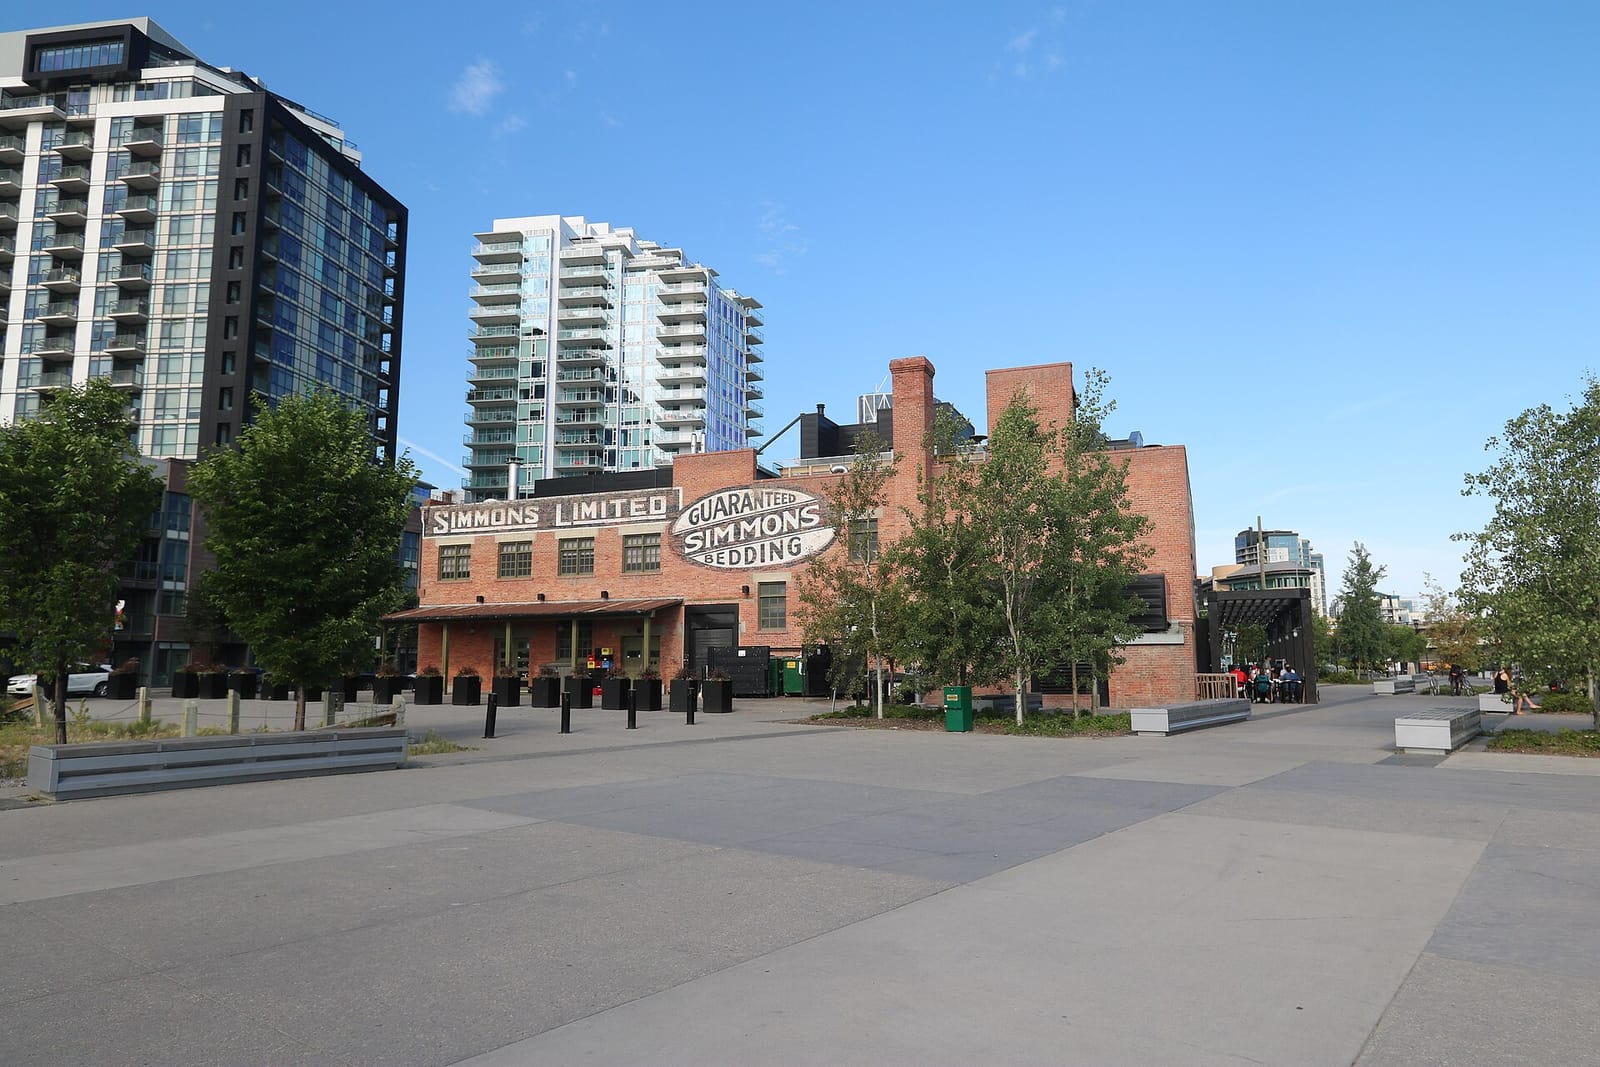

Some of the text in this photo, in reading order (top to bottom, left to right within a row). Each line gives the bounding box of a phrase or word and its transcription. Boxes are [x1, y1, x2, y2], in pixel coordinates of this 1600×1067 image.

[433, 496, 667, 534] SIMMONS LIMITED
[688, 491, 796, 526] GUARANTEED
[684, 504, 820, 551] SIMMONS
[704, 536, 802, 566] BEDDING
